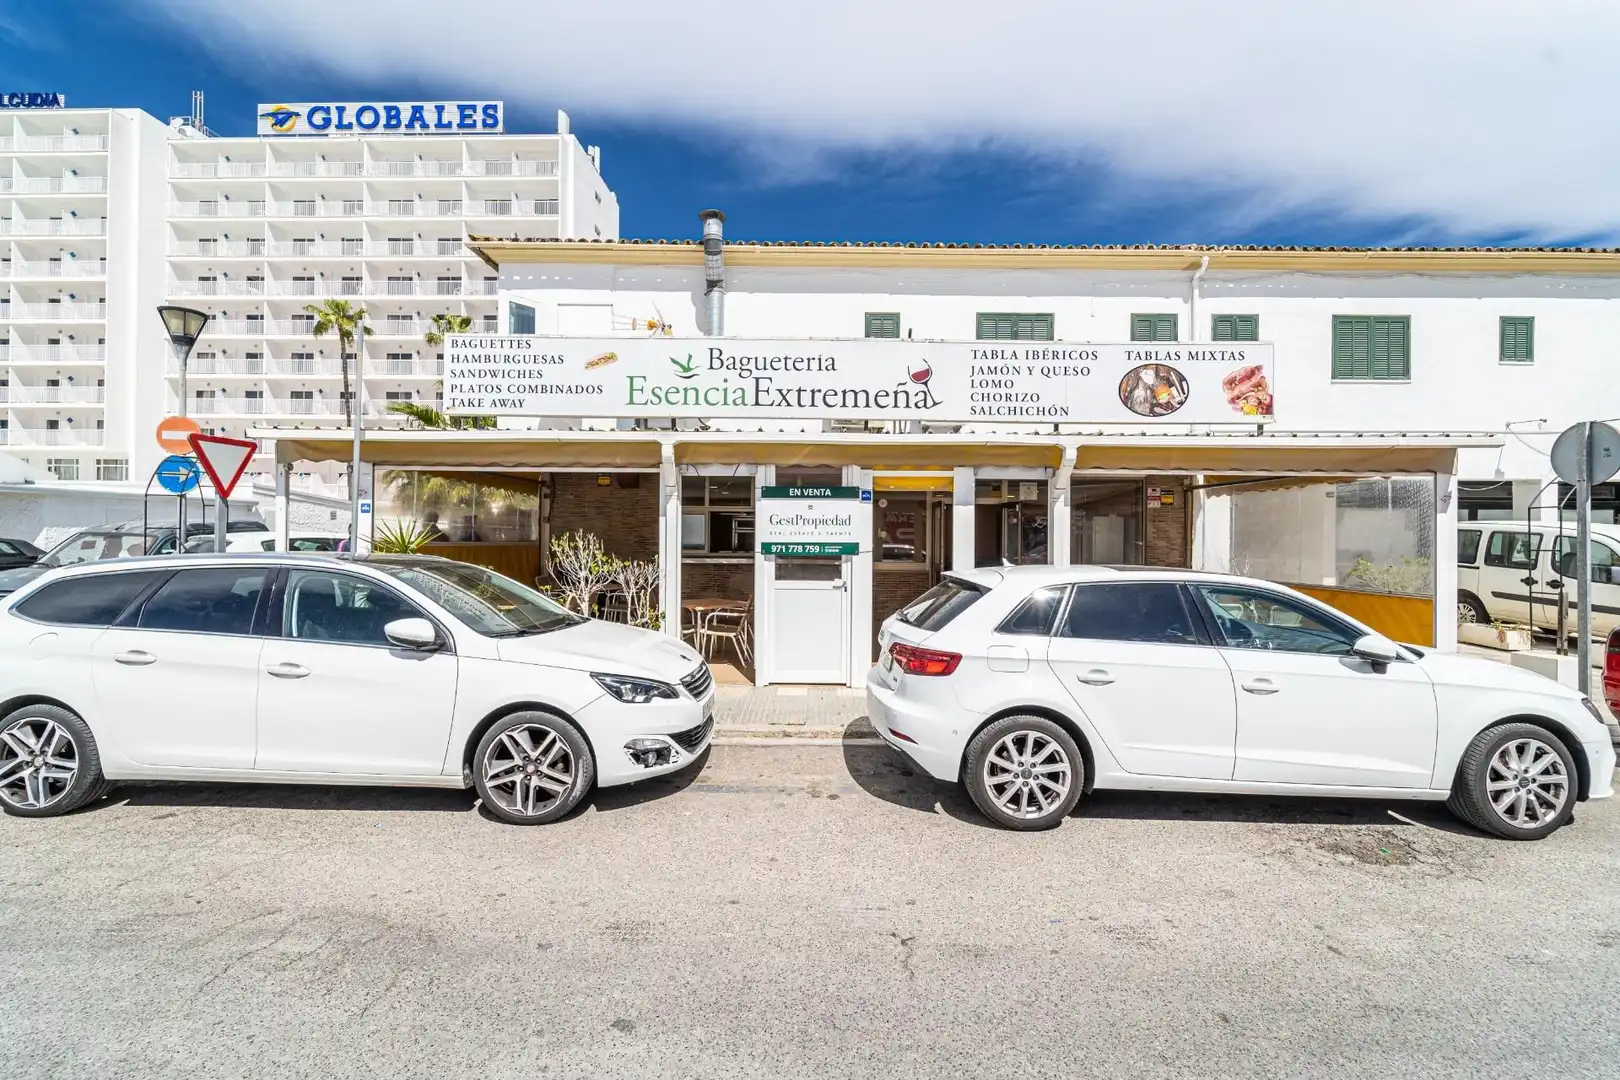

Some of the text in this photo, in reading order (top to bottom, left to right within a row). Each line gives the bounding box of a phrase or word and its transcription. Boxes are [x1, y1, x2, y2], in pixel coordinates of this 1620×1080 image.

[306, 104, 500, 131] GLOBALES
[450, 339, 532, 350] BAGUETTES
[450, 354, 565, 365] HAMBURGUESAS
[970, 347, 1099, 361] TABLA IBÉRICOS
[1124, 350, 1246, 361] TABLAS MIXTAS
[707, 347, 837, 379] Baguetería
[450, 369, 543, 379] SANDWICHES
[969, 363, 1091, 379] JAMÓN Y QUESO
[450, 384, 603, 395] PLATOS COMBINADOS
[970, 379, 1014, 389] LOMO
[970, 392, 1040, 403] CHORIZO
[450, 398, 526, 409] TAKE AWAY
[970, 404, 1070, 417] SALCHICHÓN
[789, 488, 832, 496] EN VENTA
[769, 513, 851, 530] GestPropiedad
[771, 545, 786, 553] 971
[788, 545, 803, 553] 778
[804, 545, 820, 553] 759
